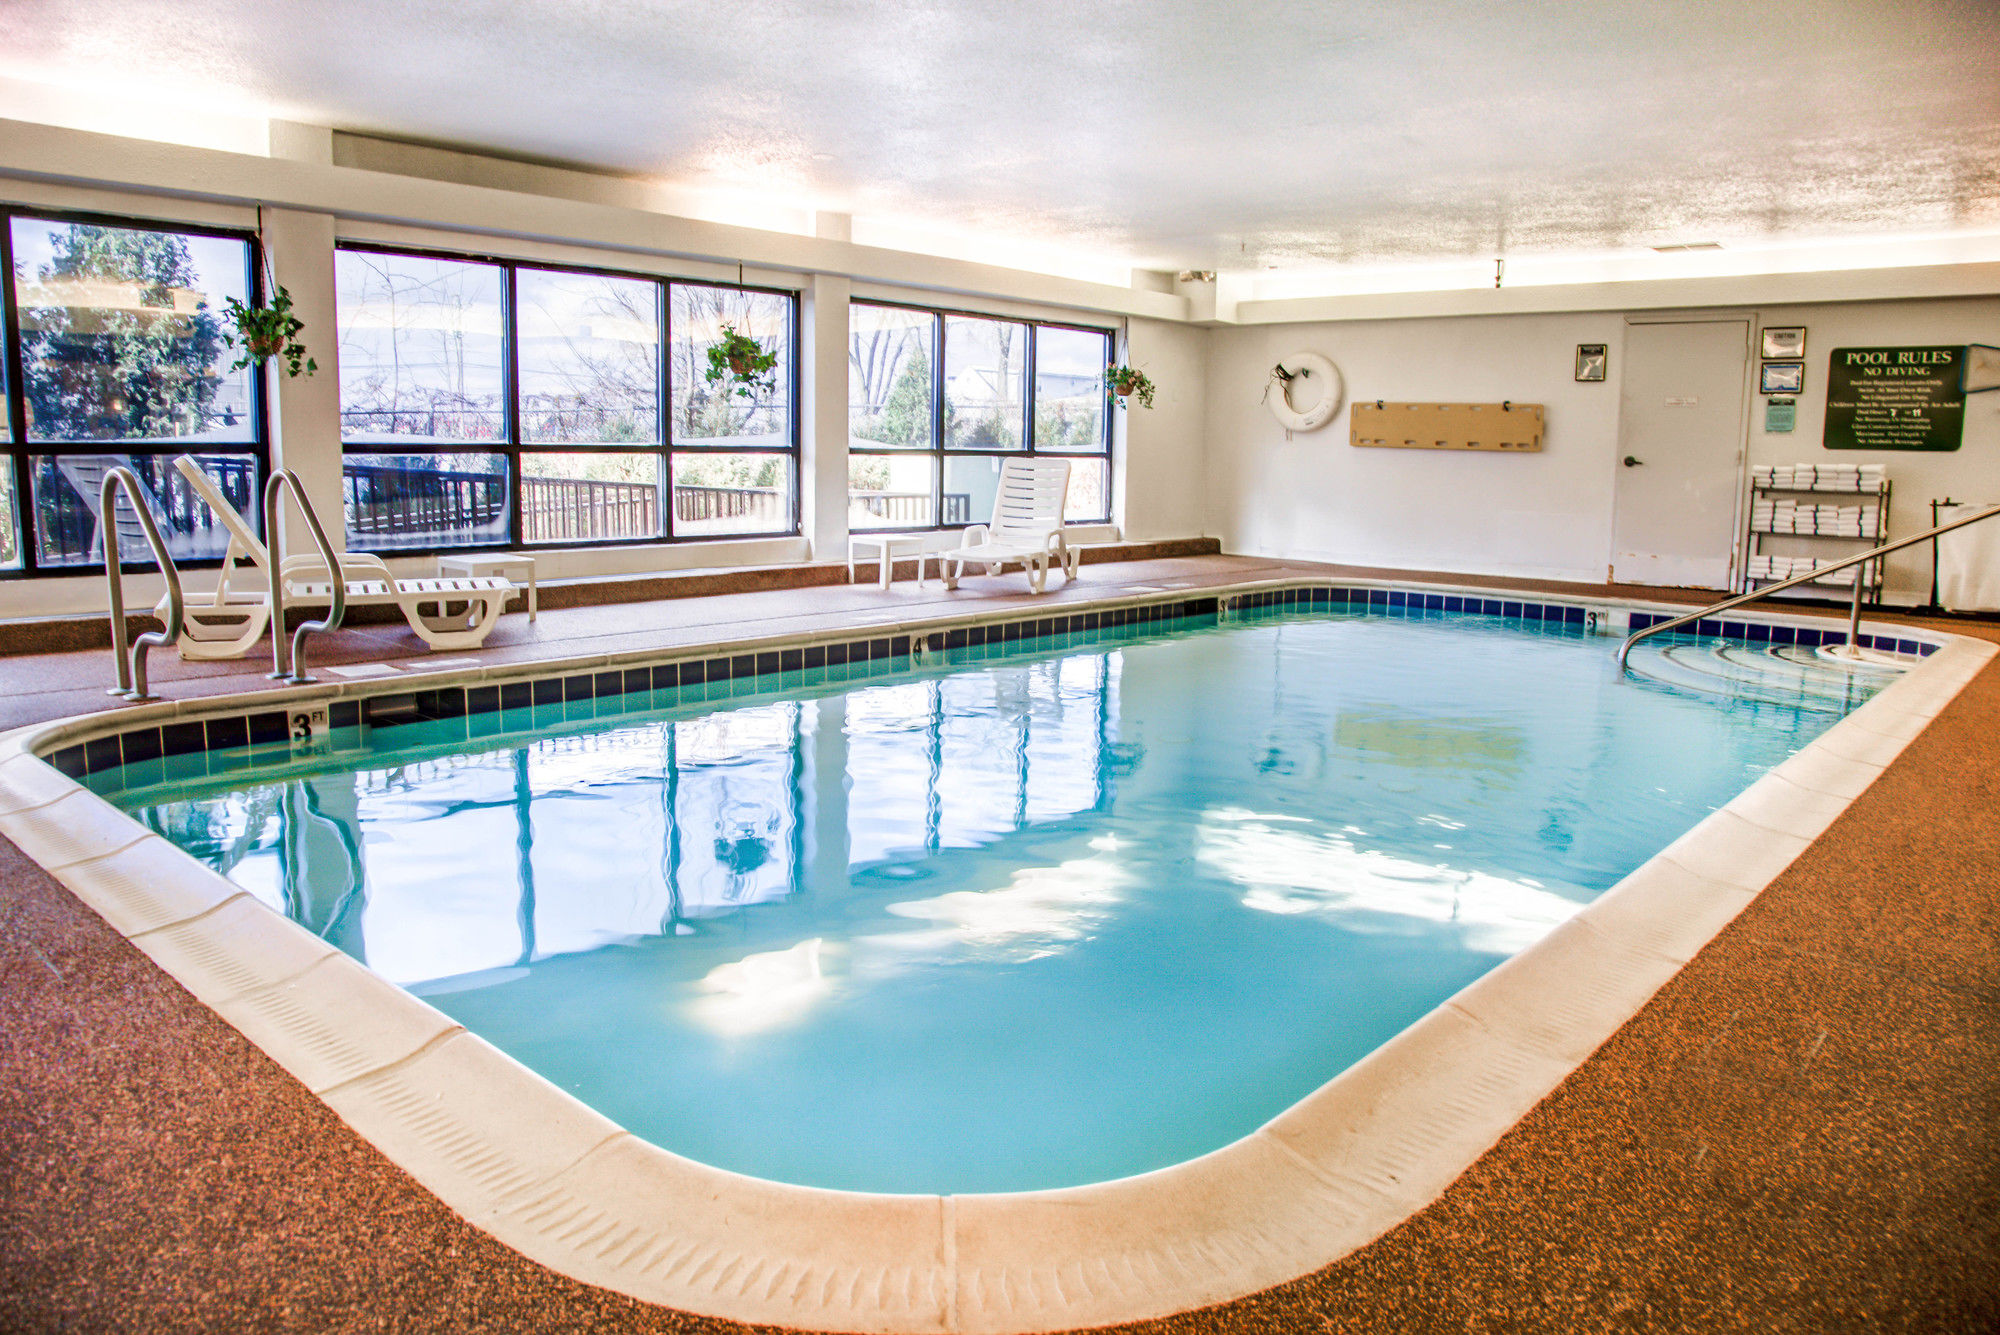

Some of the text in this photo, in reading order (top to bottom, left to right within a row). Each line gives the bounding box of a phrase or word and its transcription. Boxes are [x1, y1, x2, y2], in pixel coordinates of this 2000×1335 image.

[1846, 351, 1952, 365] POOL RULES
[1863, 366, 1931, 376] NO DIVING
[1587, 612, 1597, 630] 3
[294, 711, 324, 738] 3 FT
